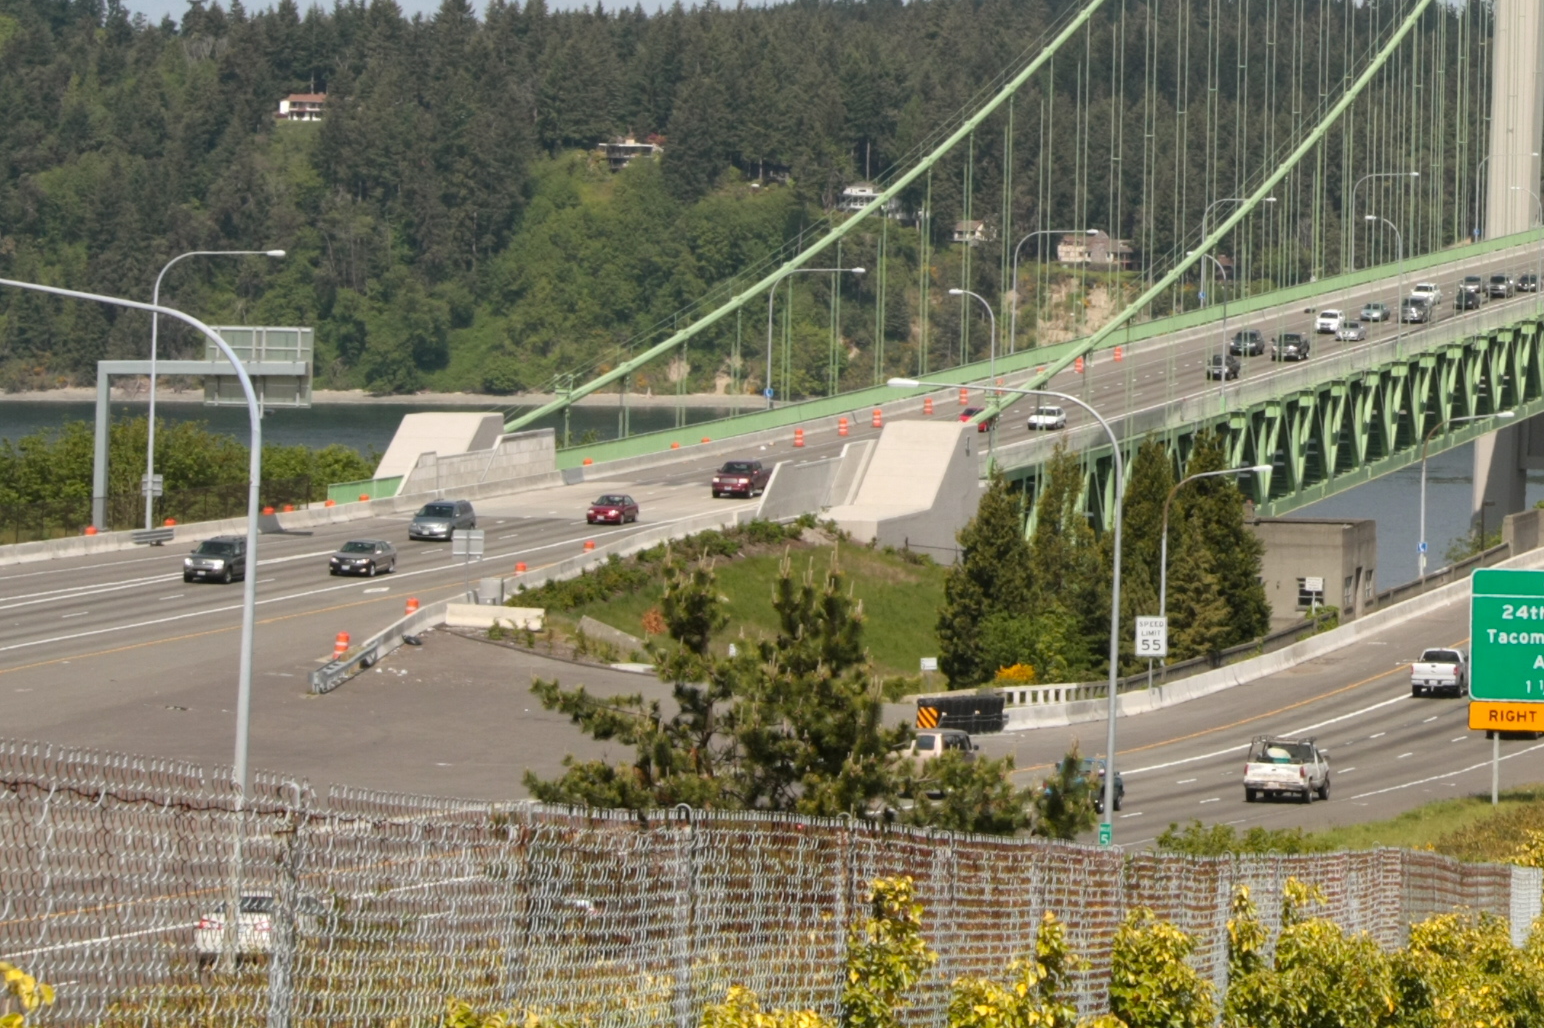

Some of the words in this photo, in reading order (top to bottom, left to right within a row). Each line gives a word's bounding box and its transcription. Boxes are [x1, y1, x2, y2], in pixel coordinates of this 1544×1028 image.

[1139, 620, 1164, 628] SPEED
[1141, 639, 1161, 651] 55
[1488, 709, 1538, 723] RIGHT
